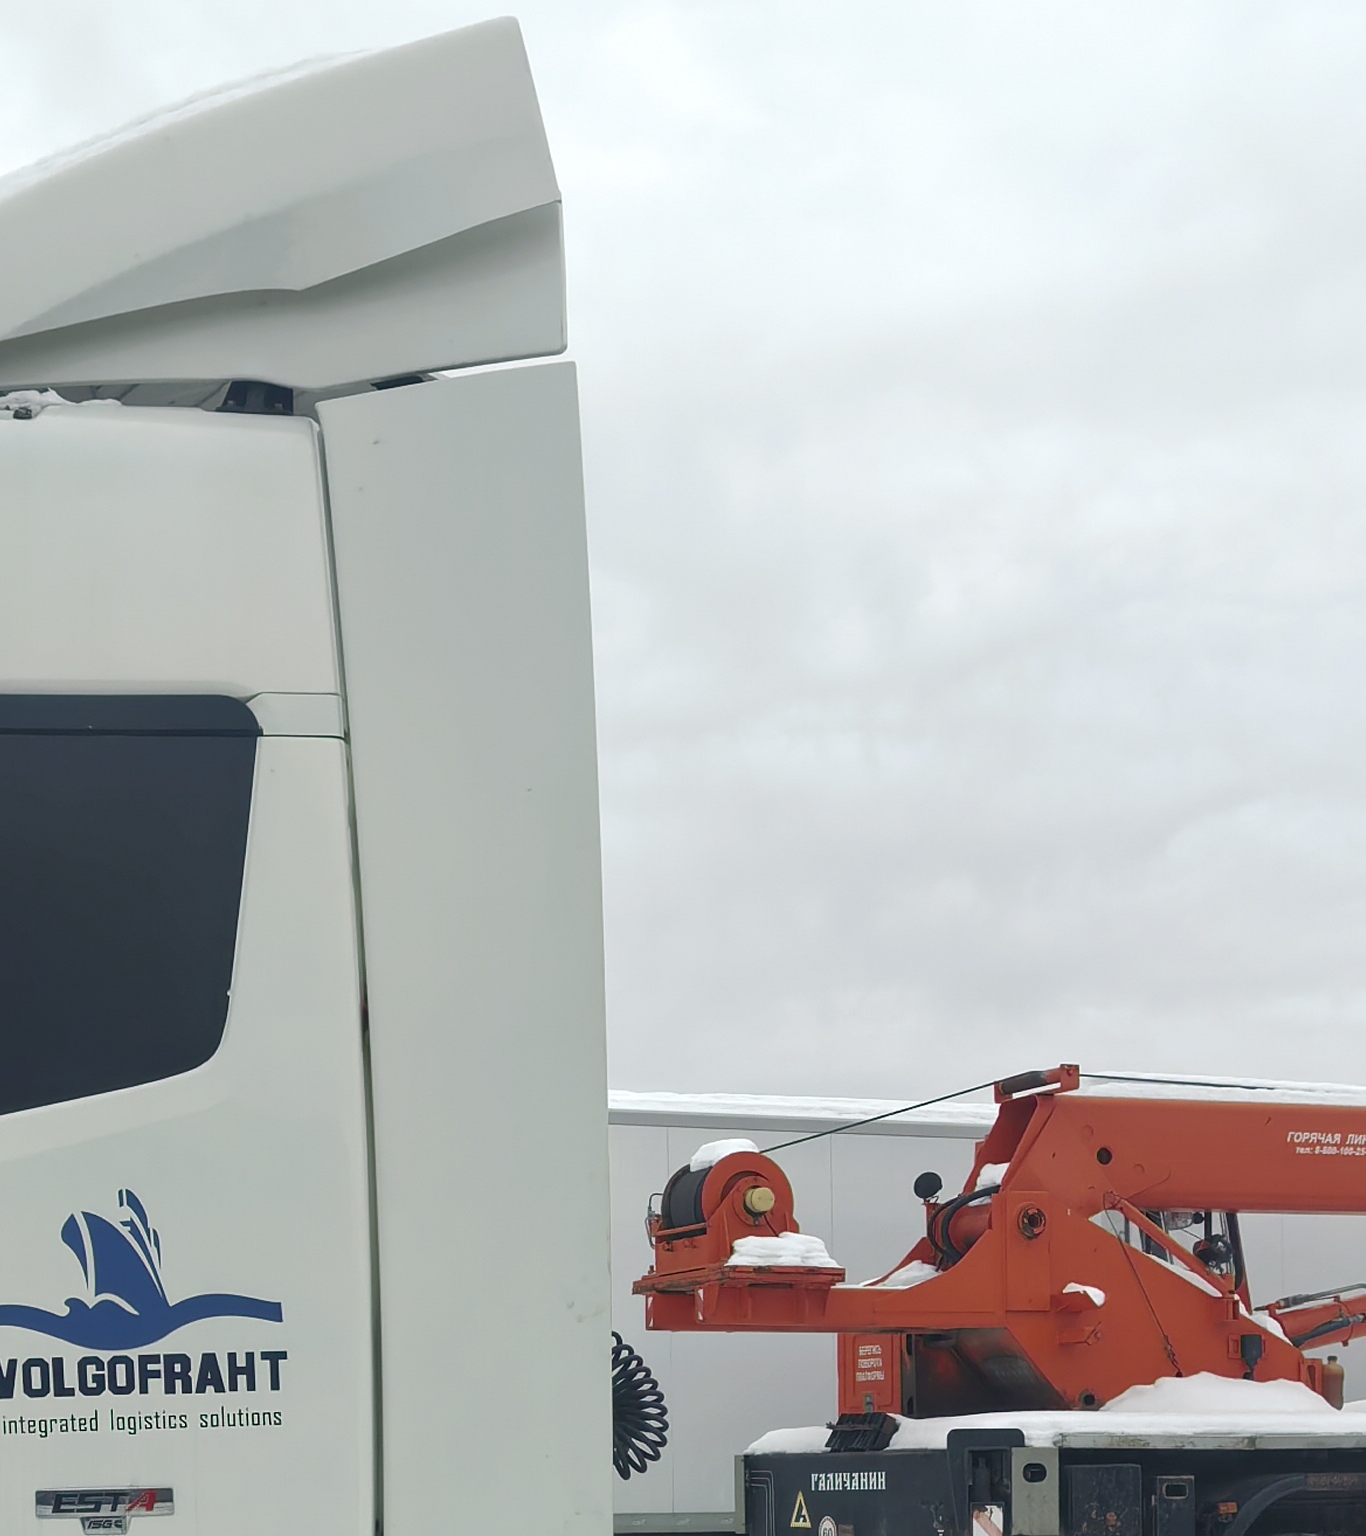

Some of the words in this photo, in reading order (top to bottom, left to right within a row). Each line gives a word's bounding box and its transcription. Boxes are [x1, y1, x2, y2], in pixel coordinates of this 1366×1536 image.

[1287, 1131, 1341, 1144] ГОРЯЧАЯ
[2, 1410, 98, 1438] integrated
[110, 1408, 188, 1435] logistics
[199, 1405, 282, 1428] solutions
[811, 1472, 886, 1491] ГАЛИЧАНИН
[51, 1490, 157, 1514] ESTA
